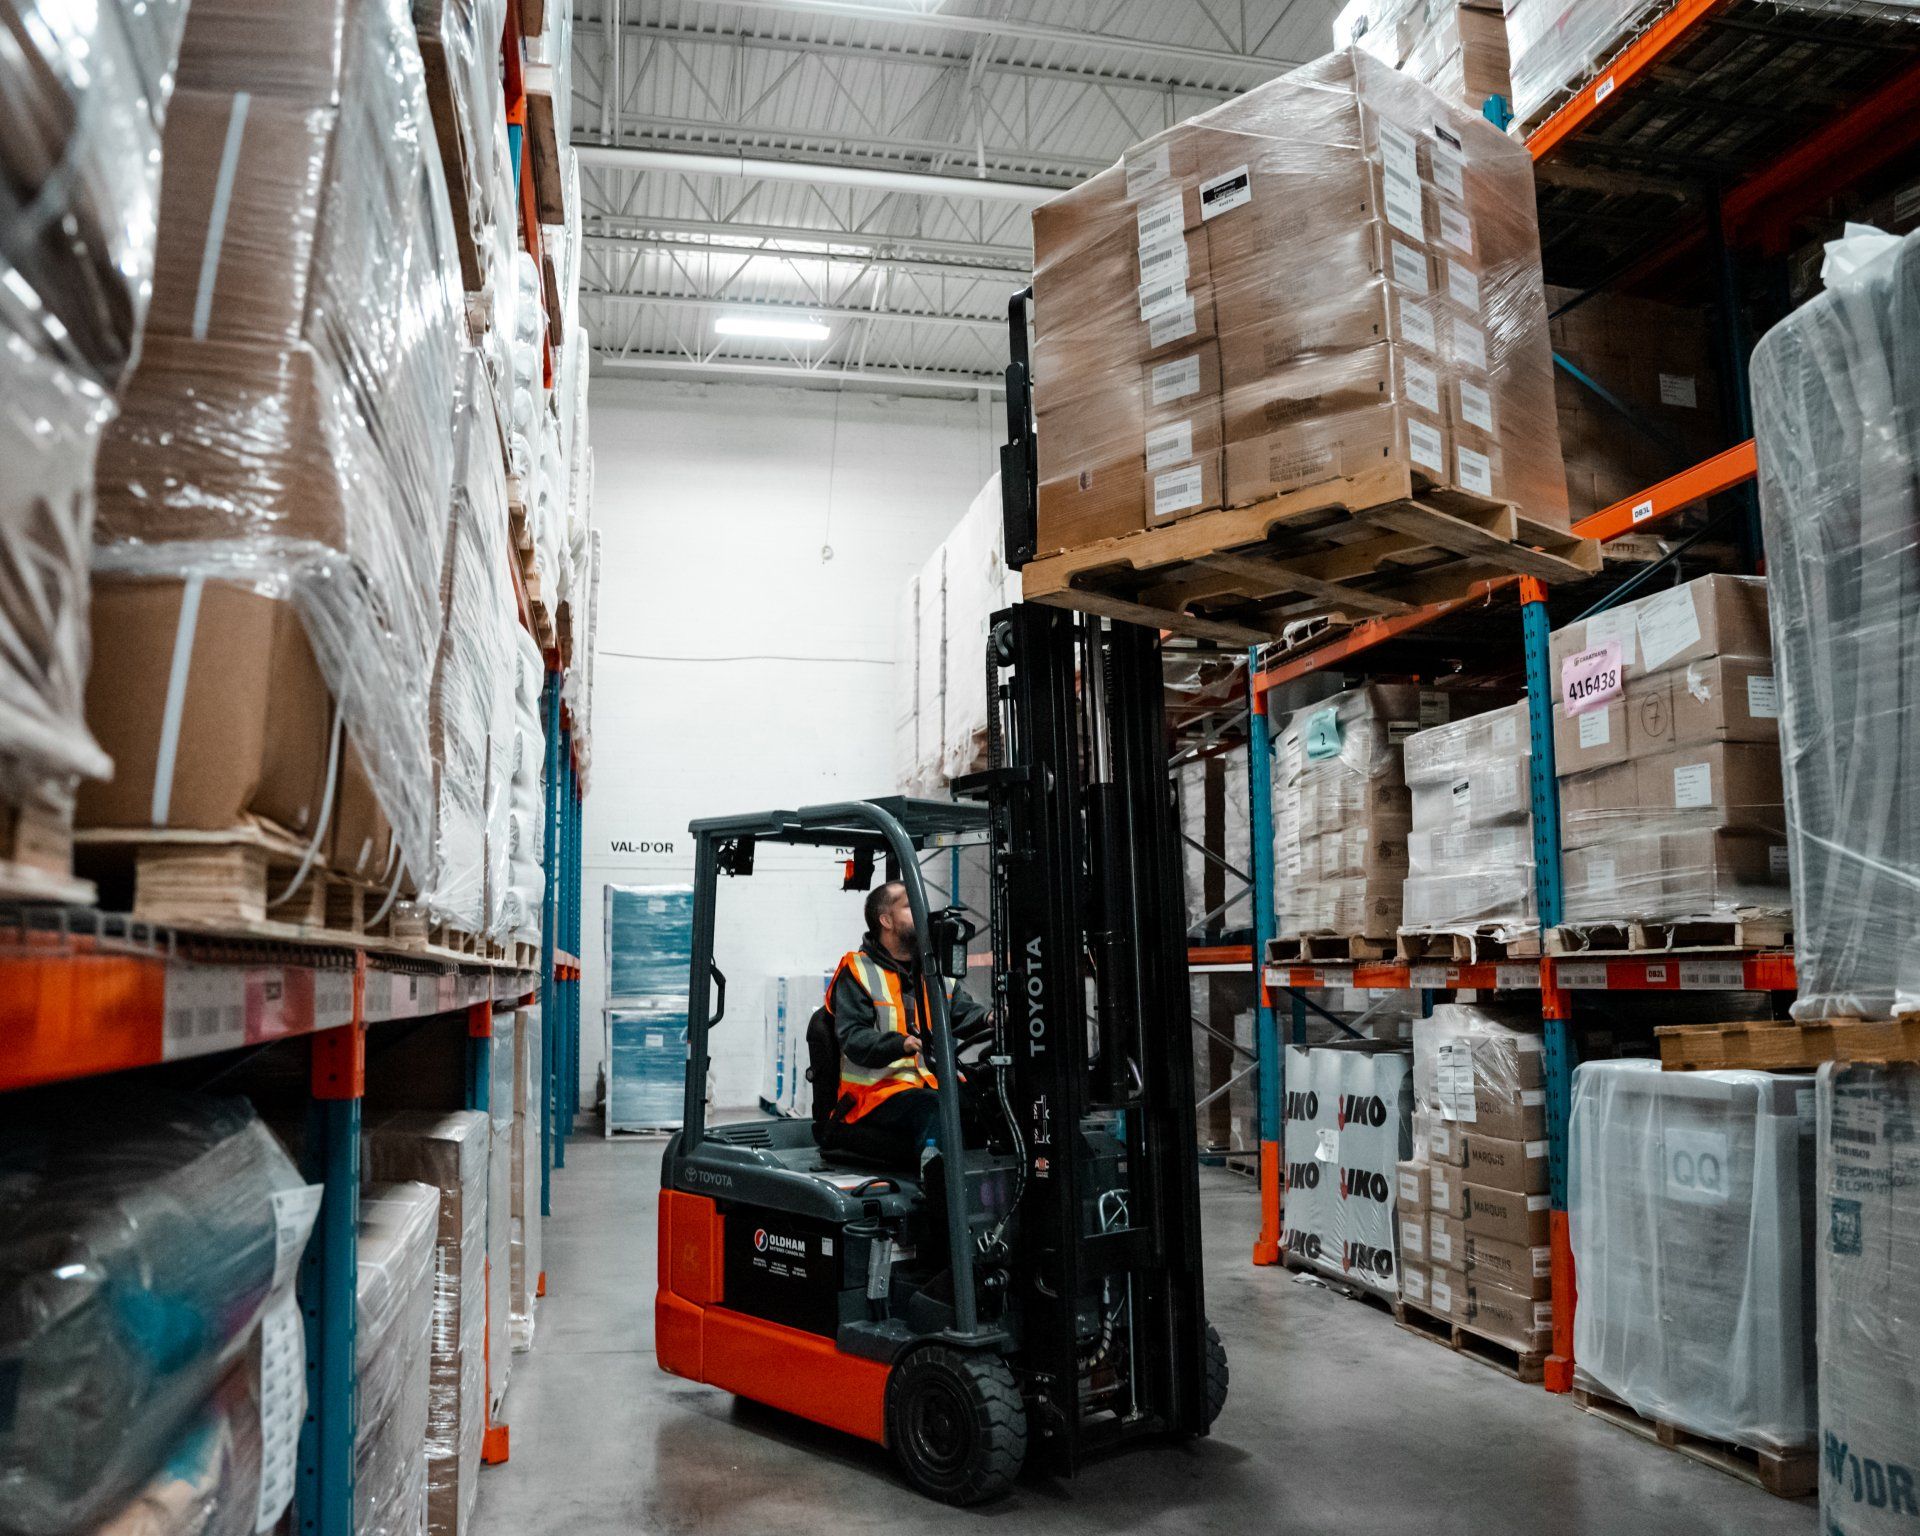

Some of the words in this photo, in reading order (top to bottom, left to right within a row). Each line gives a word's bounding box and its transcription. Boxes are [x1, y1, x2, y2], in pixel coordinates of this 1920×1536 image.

[1569, 670, 1616, 700] 416438
[1646, 701, 1661, 731] 7
[1320, 732, 1326, 746] 2
[611, 841, 674, 853] VAL-D'OR
[1027, 936, 1046, 1057] TOYOTA
[1288, 1090, 1318, 1121] IKO
[1344, 1094, 1387, 1127] IKO
[1476, 1101, 1501, 1114] ARQUIS
[1472, 1150, 1505, 1165] MARQUIS
[698, 1170, 733, 1187] TOYOTA
[1289, 1162, 1320, 1189] IKO
[1673, 1150, 1721, 1193] QQ
[1347, 1168, 1389, 1203] IKO
[1474, 1201, 1507, 1218] MARQUIS
[769, 1234, 806, 1252] OLDHAM
